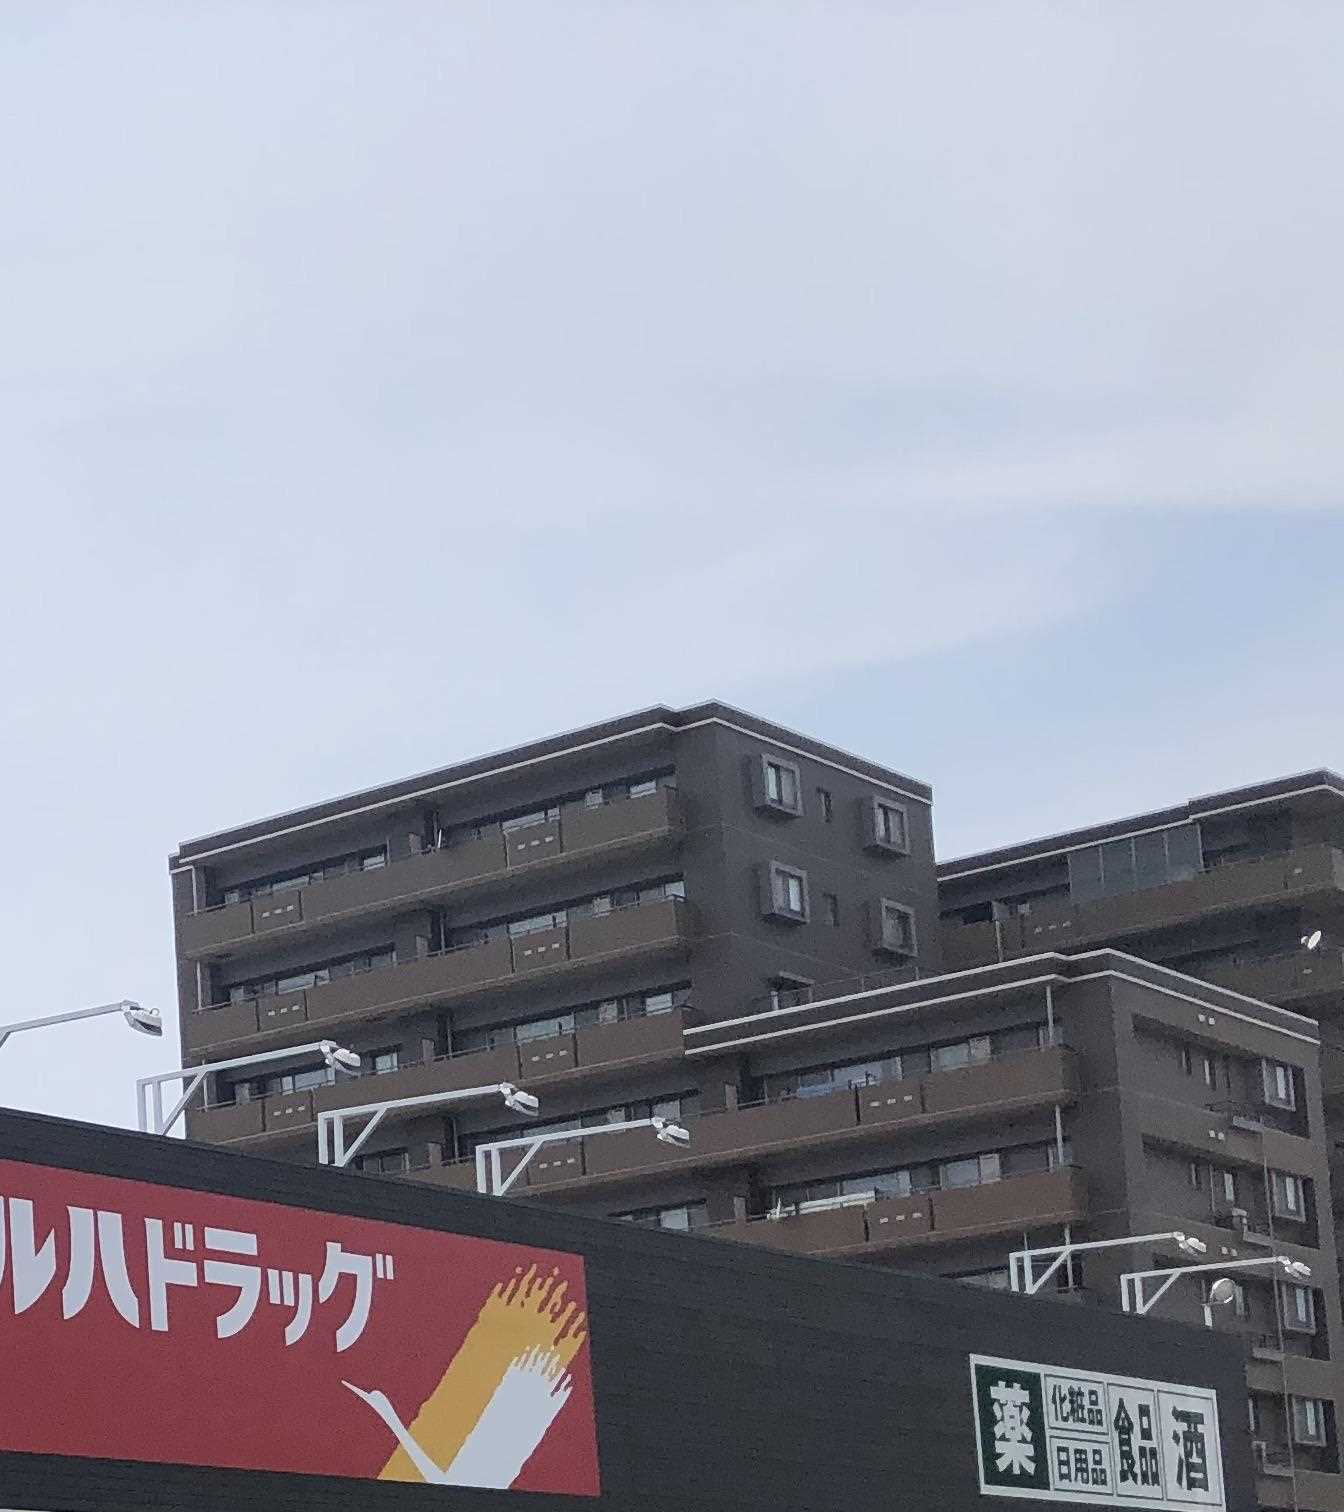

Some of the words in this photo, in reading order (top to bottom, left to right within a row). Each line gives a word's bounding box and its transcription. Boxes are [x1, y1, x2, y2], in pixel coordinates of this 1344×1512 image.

[989, 1380, 1036, 1475] 薬
[1051, 1383, 1103, 1427] 化粧品
[1114, 1396, 1160, 1487] 食品
[1171, 1405, 1210, 1492] 酒
[1056, 1444, 1108, 1487] 日用品
